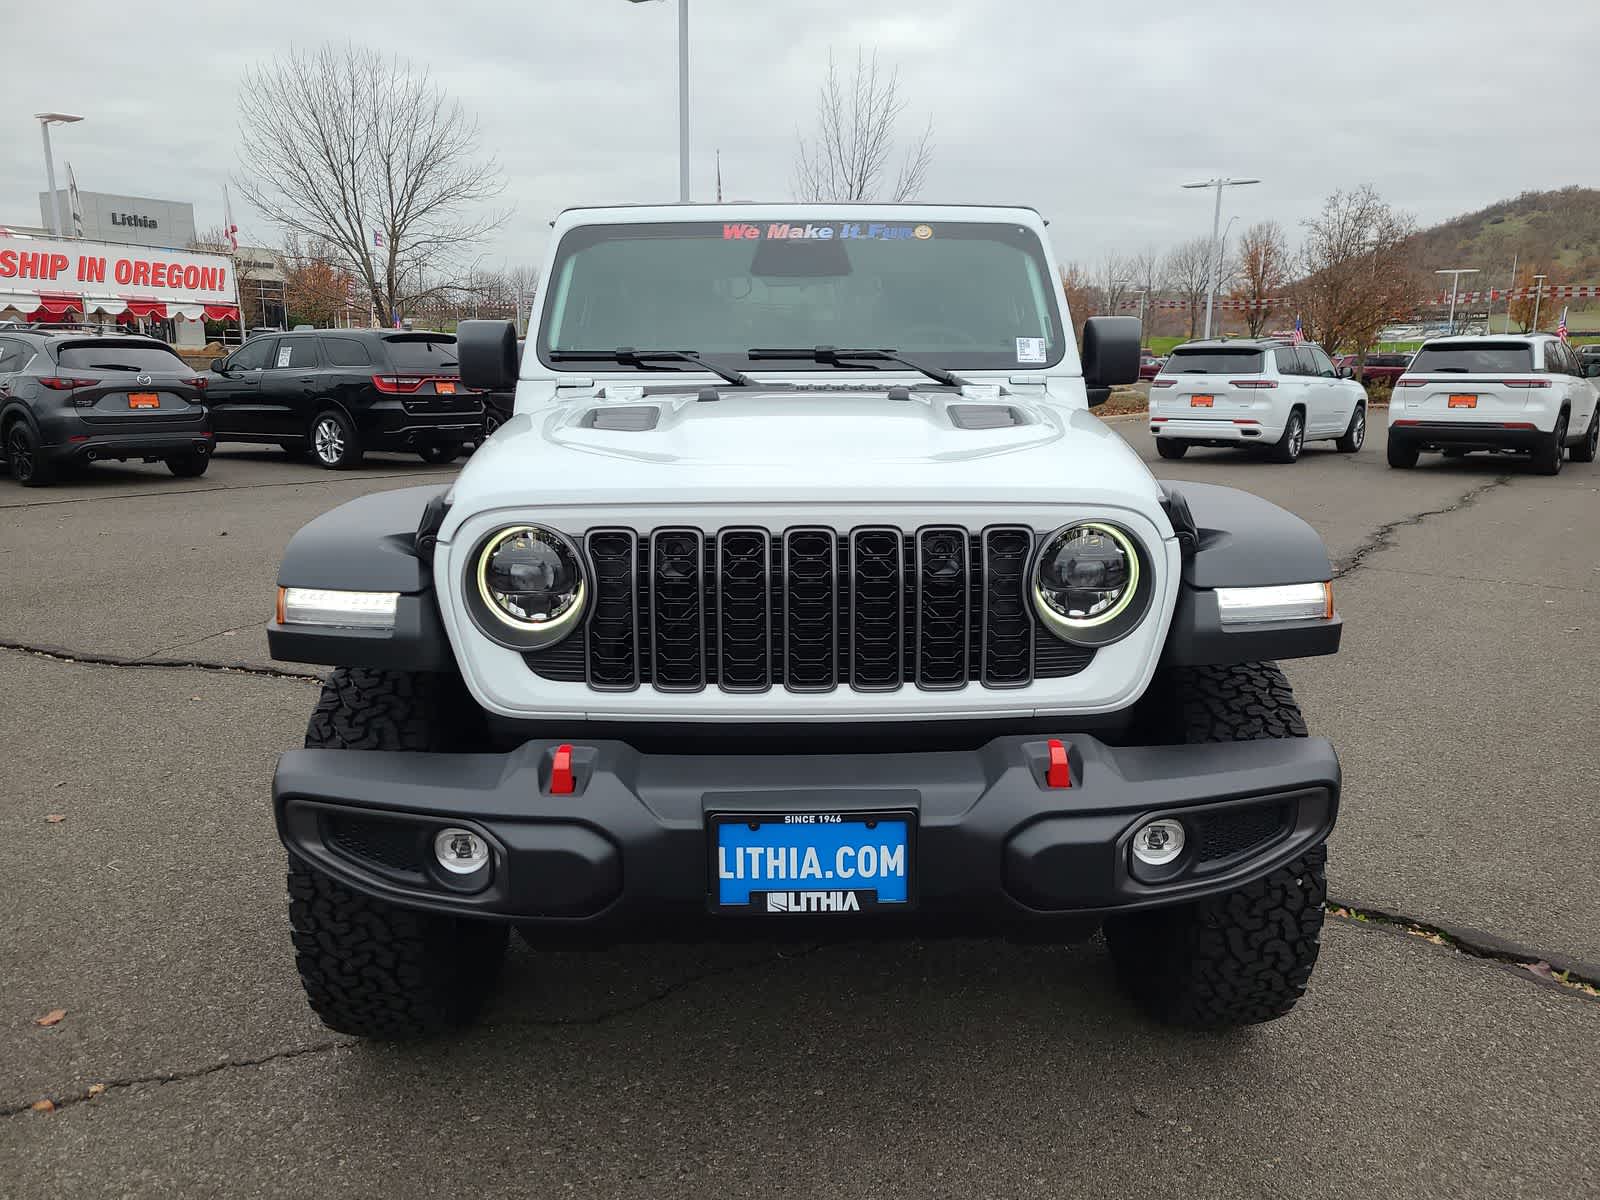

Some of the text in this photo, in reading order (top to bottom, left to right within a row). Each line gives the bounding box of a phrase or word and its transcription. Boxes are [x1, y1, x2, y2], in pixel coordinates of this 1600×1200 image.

[111, 212, 158, 229] Lithia
[722, 224, 761, 240] We
[767, 224, 833, 240] Make
[0, 249, 226, 292] SHIP IN OREGON!
[784, 815, 842, 824] SINCE 1946
[718, 845, 905, 879] LITHIA.COM
[788, 891, 860, 912] LITHIA
